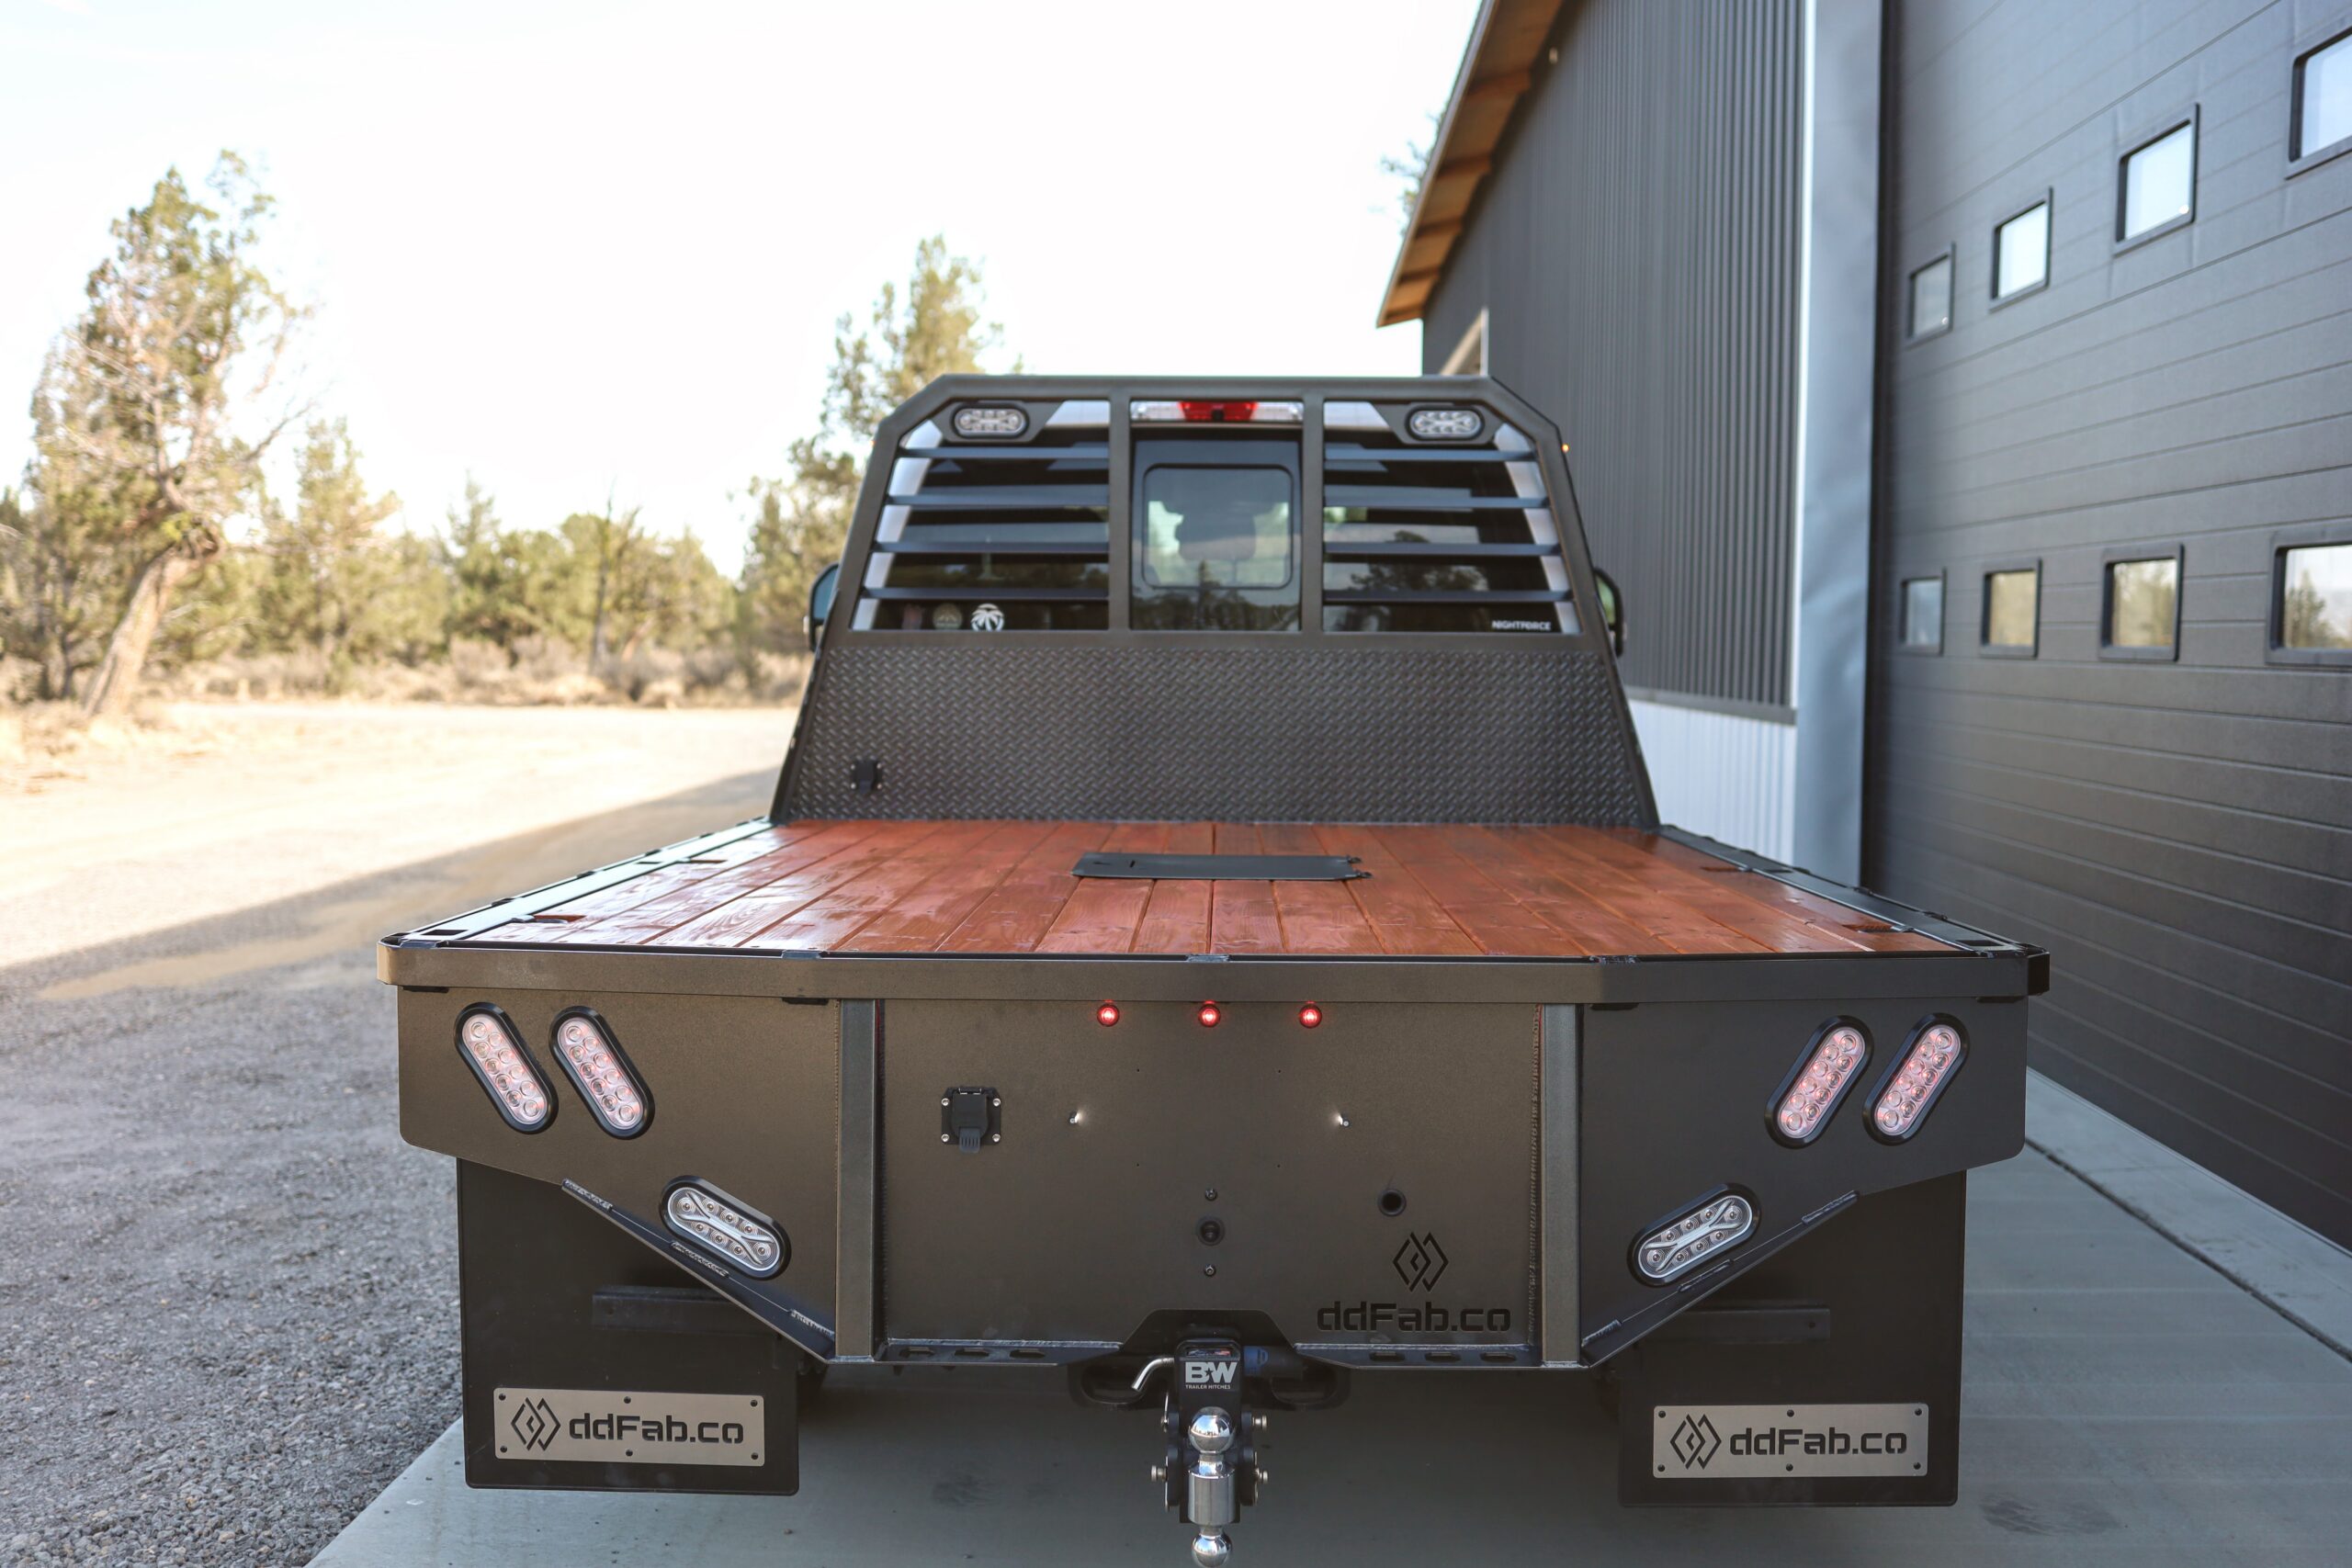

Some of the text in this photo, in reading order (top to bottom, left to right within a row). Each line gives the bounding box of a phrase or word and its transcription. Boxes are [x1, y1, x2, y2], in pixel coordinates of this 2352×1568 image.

[1317, 1301, 1511, 1332] ddFab.co
[569, 1413, 744, 1444] ddFab.co
[1730, 1427, 1907, 1455] ddFab.co
